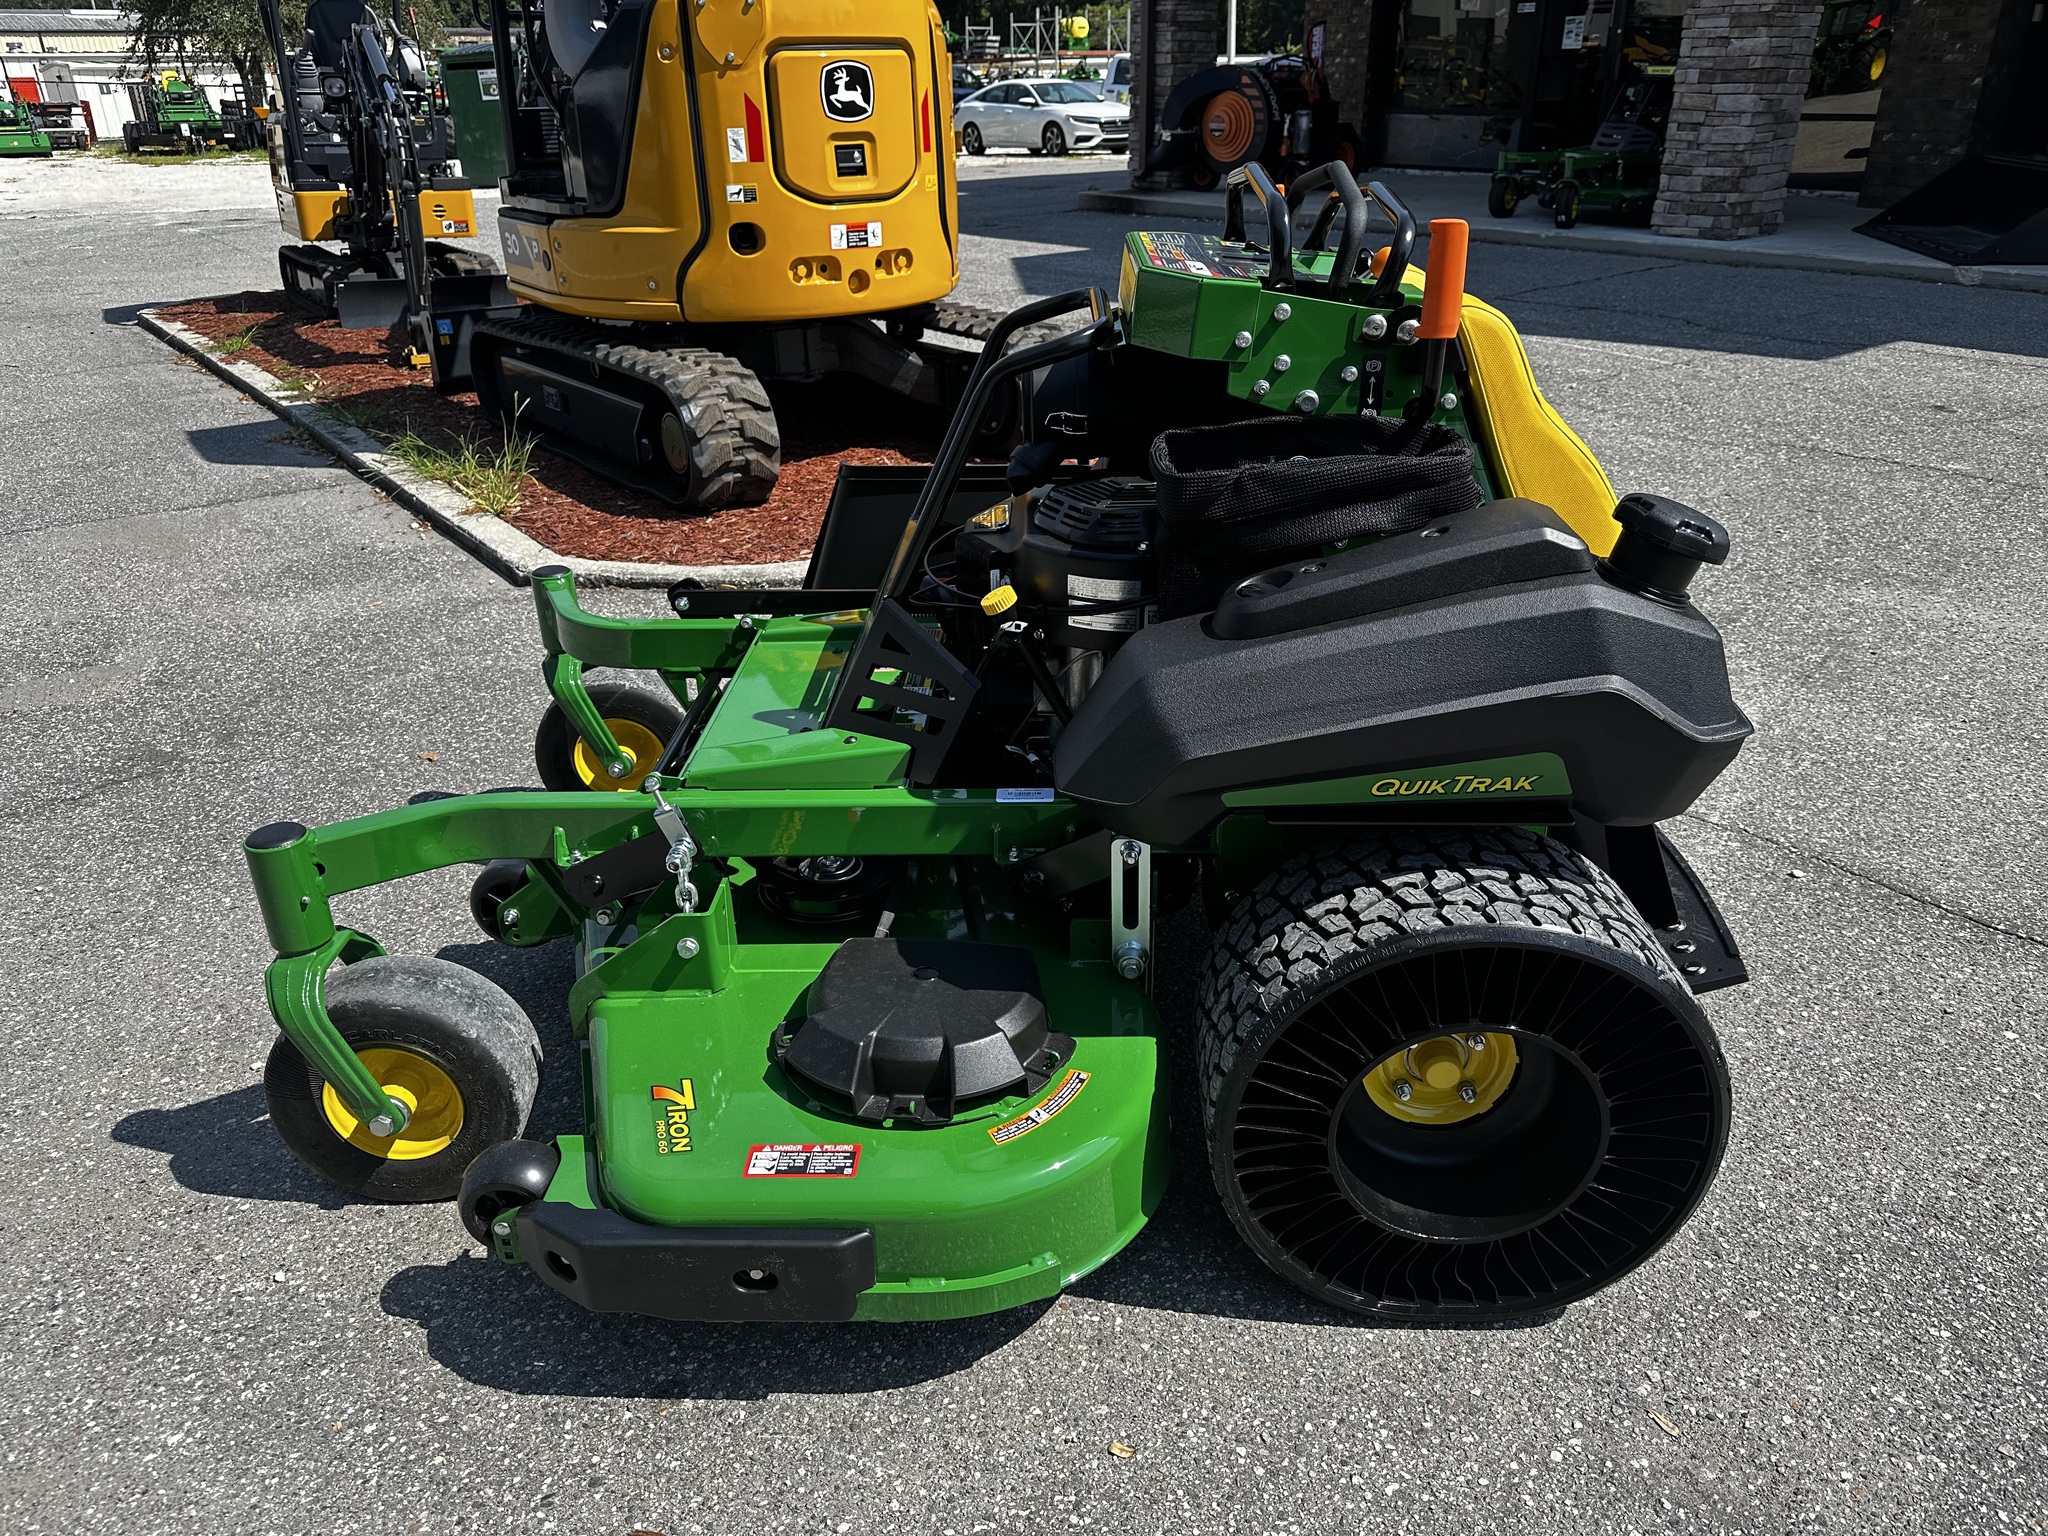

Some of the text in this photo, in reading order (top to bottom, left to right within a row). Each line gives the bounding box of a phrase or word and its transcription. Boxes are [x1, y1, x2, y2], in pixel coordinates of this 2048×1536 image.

[505, 232, 520, 256] 30
[344, 1027, 457, 1064] CARLSTAR
[655, 1119, 669, 1154] PRO 60
